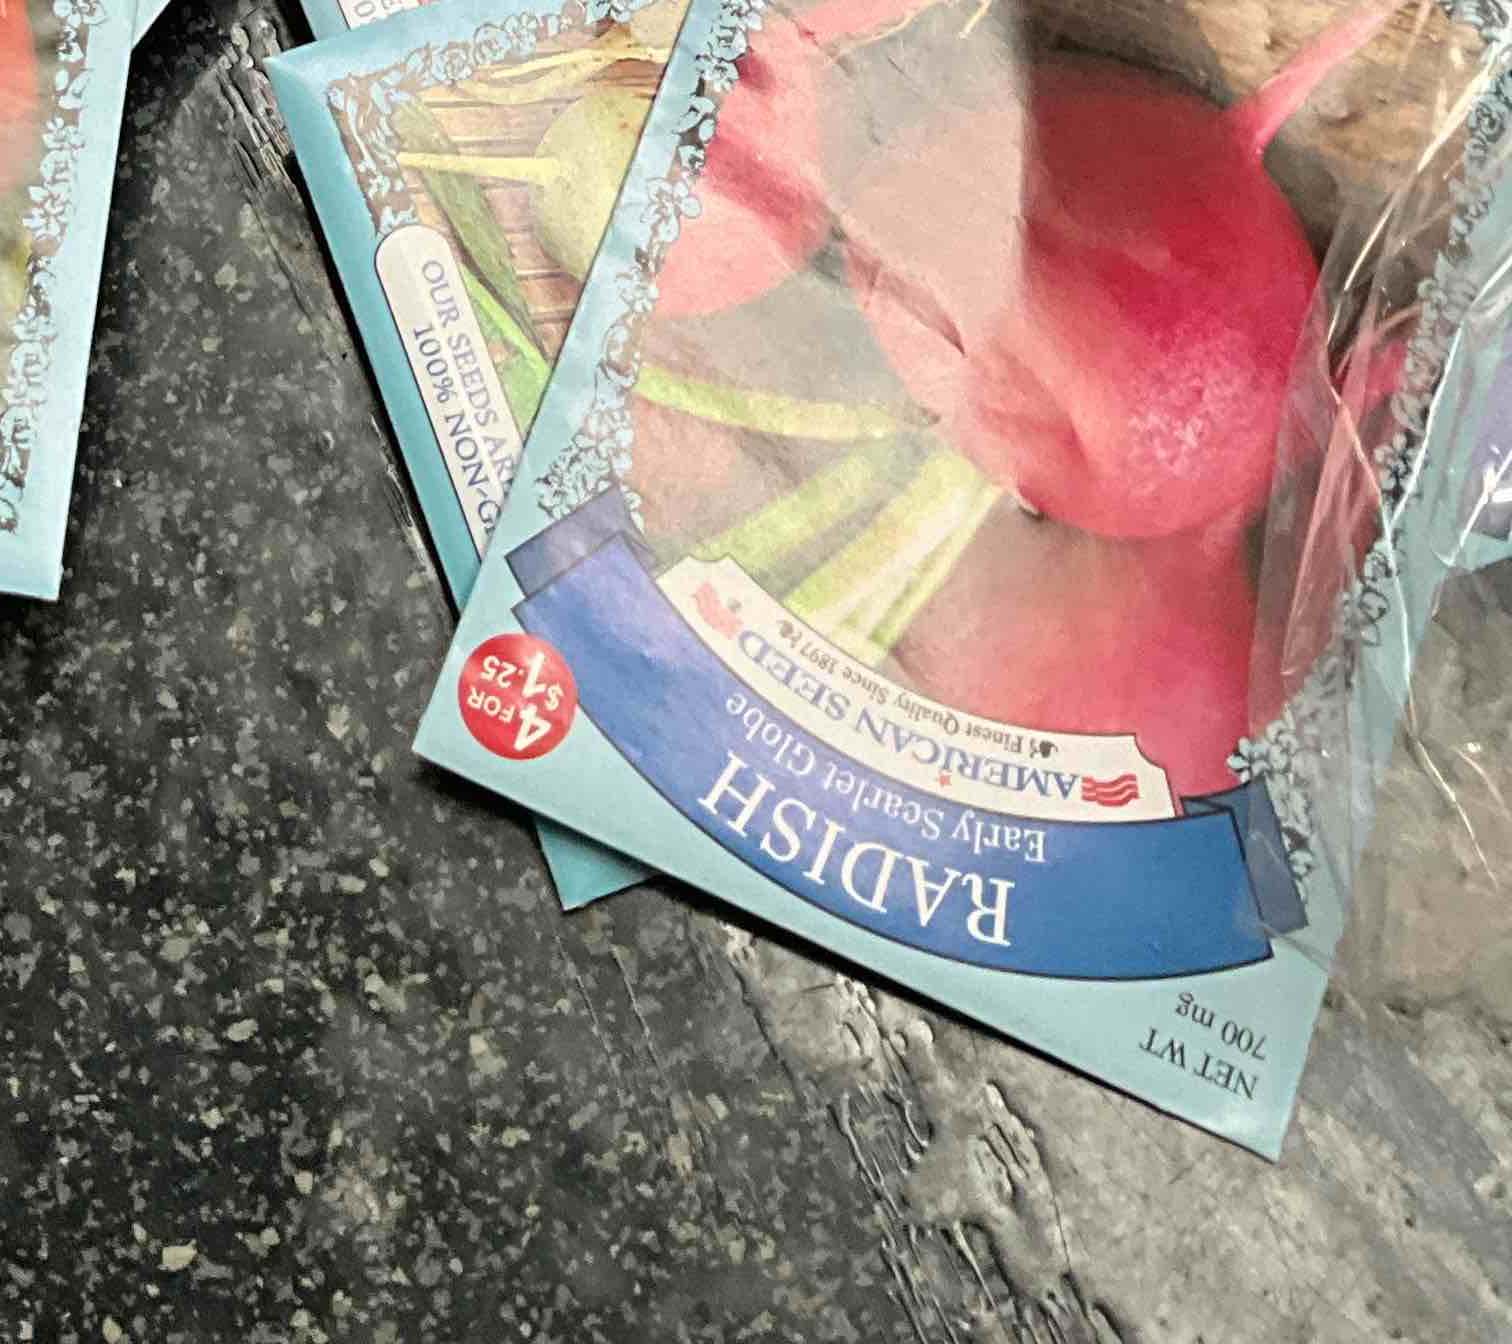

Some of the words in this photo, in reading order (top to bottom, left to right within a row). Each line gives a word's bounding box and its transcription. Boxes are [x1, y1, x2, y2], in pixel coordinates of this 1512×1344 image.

[737, 630, 853, 722] SEED
[795, 637, 838, 675] 1897
[466, 687, 514, 722] FOR
[841, 665, 888, 705] Since
[514, 706, 552, 750] 4
[724, 691, 819, 777] Globe
[893, 687, 961, 735] Quality
[856, 710, 1078, 802] AMERICAN
[964, 721, 1023, 758] Finest
[822, 757, 942, 842] Scarlet
[697, 752, 1016, 947] RADISH
[952, 807, 1047, 862] Early
[1175, 992, 1215, 1028] mg
[1139, 1027, 1185, 1071] WT
[1221, 1020, 1266, 1060] 700
[1194, 1051, 1258, 1100] NET
